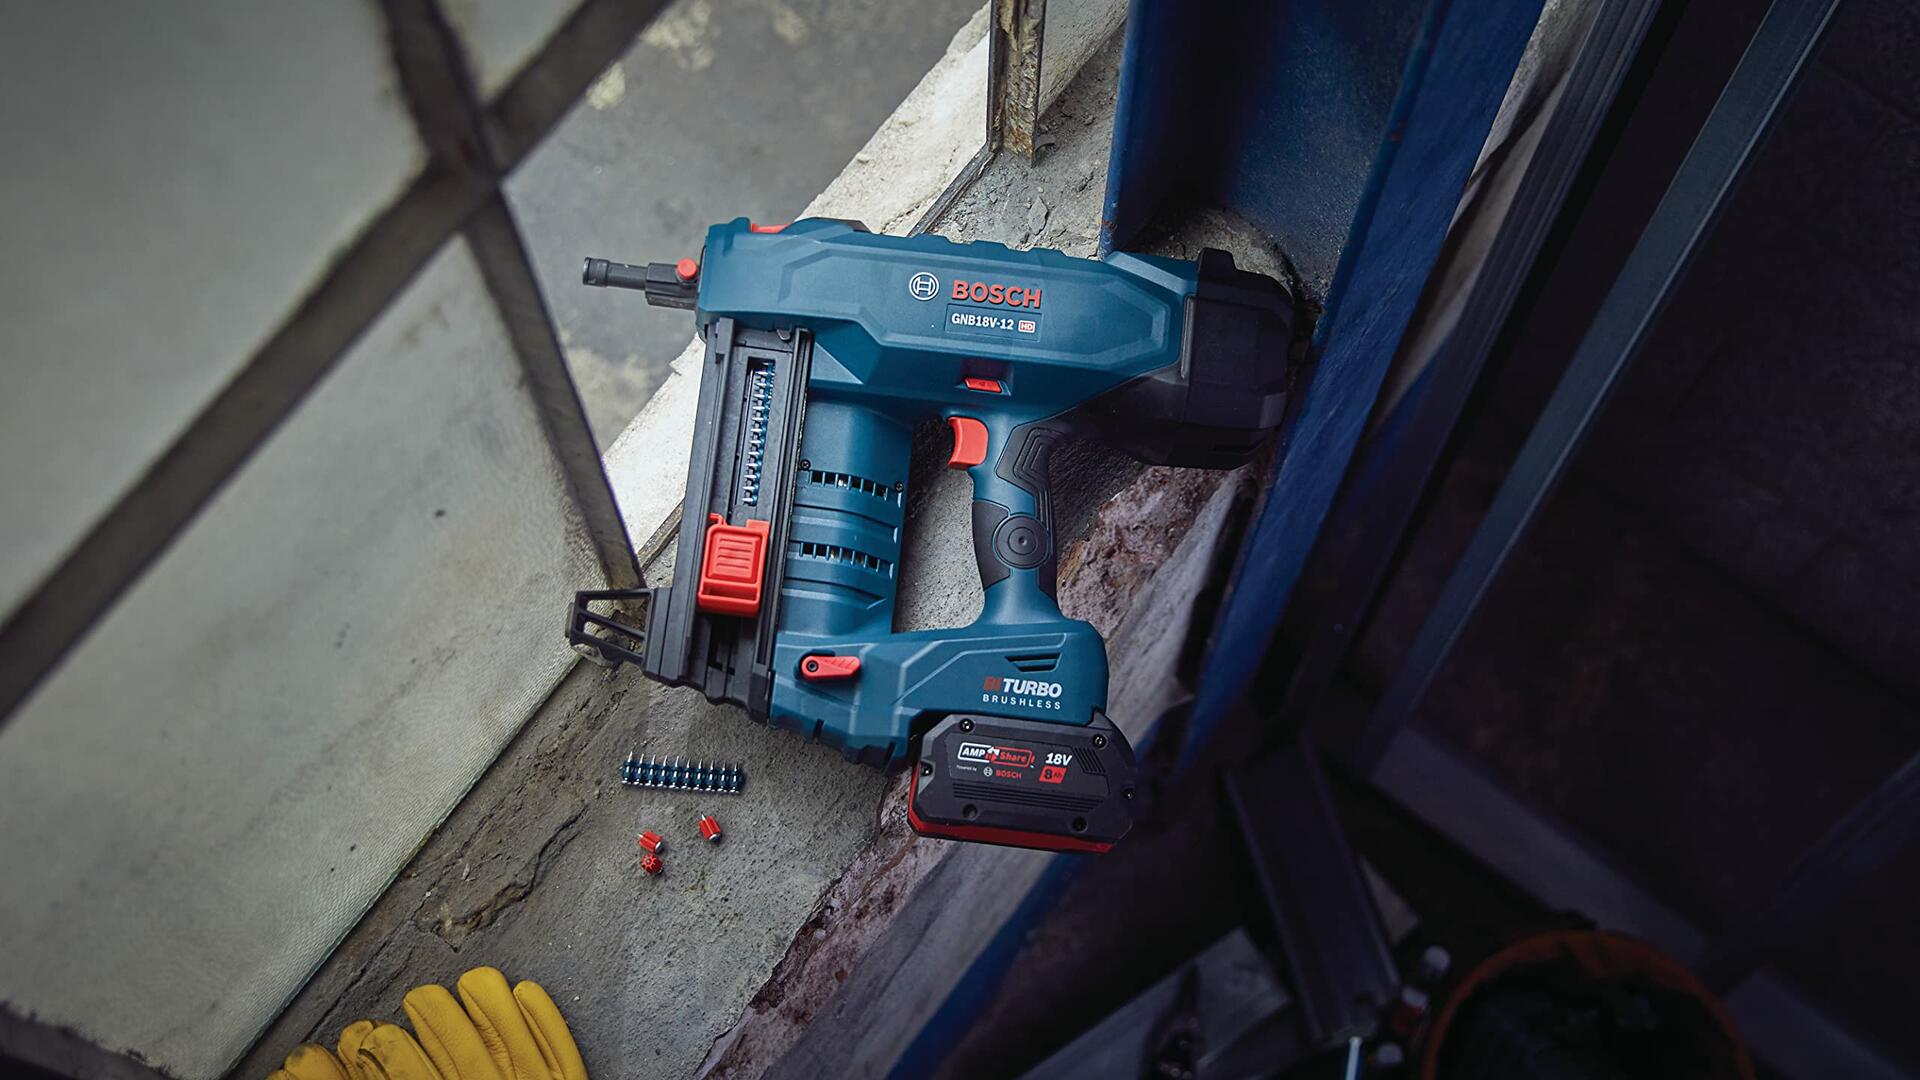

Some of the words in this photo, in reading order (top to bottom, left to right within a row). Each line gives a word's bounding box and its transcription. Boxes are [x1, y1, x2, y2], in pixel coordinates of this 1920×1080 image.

[952, 279, 1041, 308] BOSCH
[951, 312, 1014, 330] GNB18V-12
[1020, 322, 1034, 331] HD
[982, 694, 1061, 710] BRUSHLESS
[962, 747, 986, 757] AMP
[1000, 751, 1027, 763] Share
[1045, 752, 1072, 766] 18V
[995, 769, 1022, 779] BOSCH
[1044, 768, 1053, 780] 8
